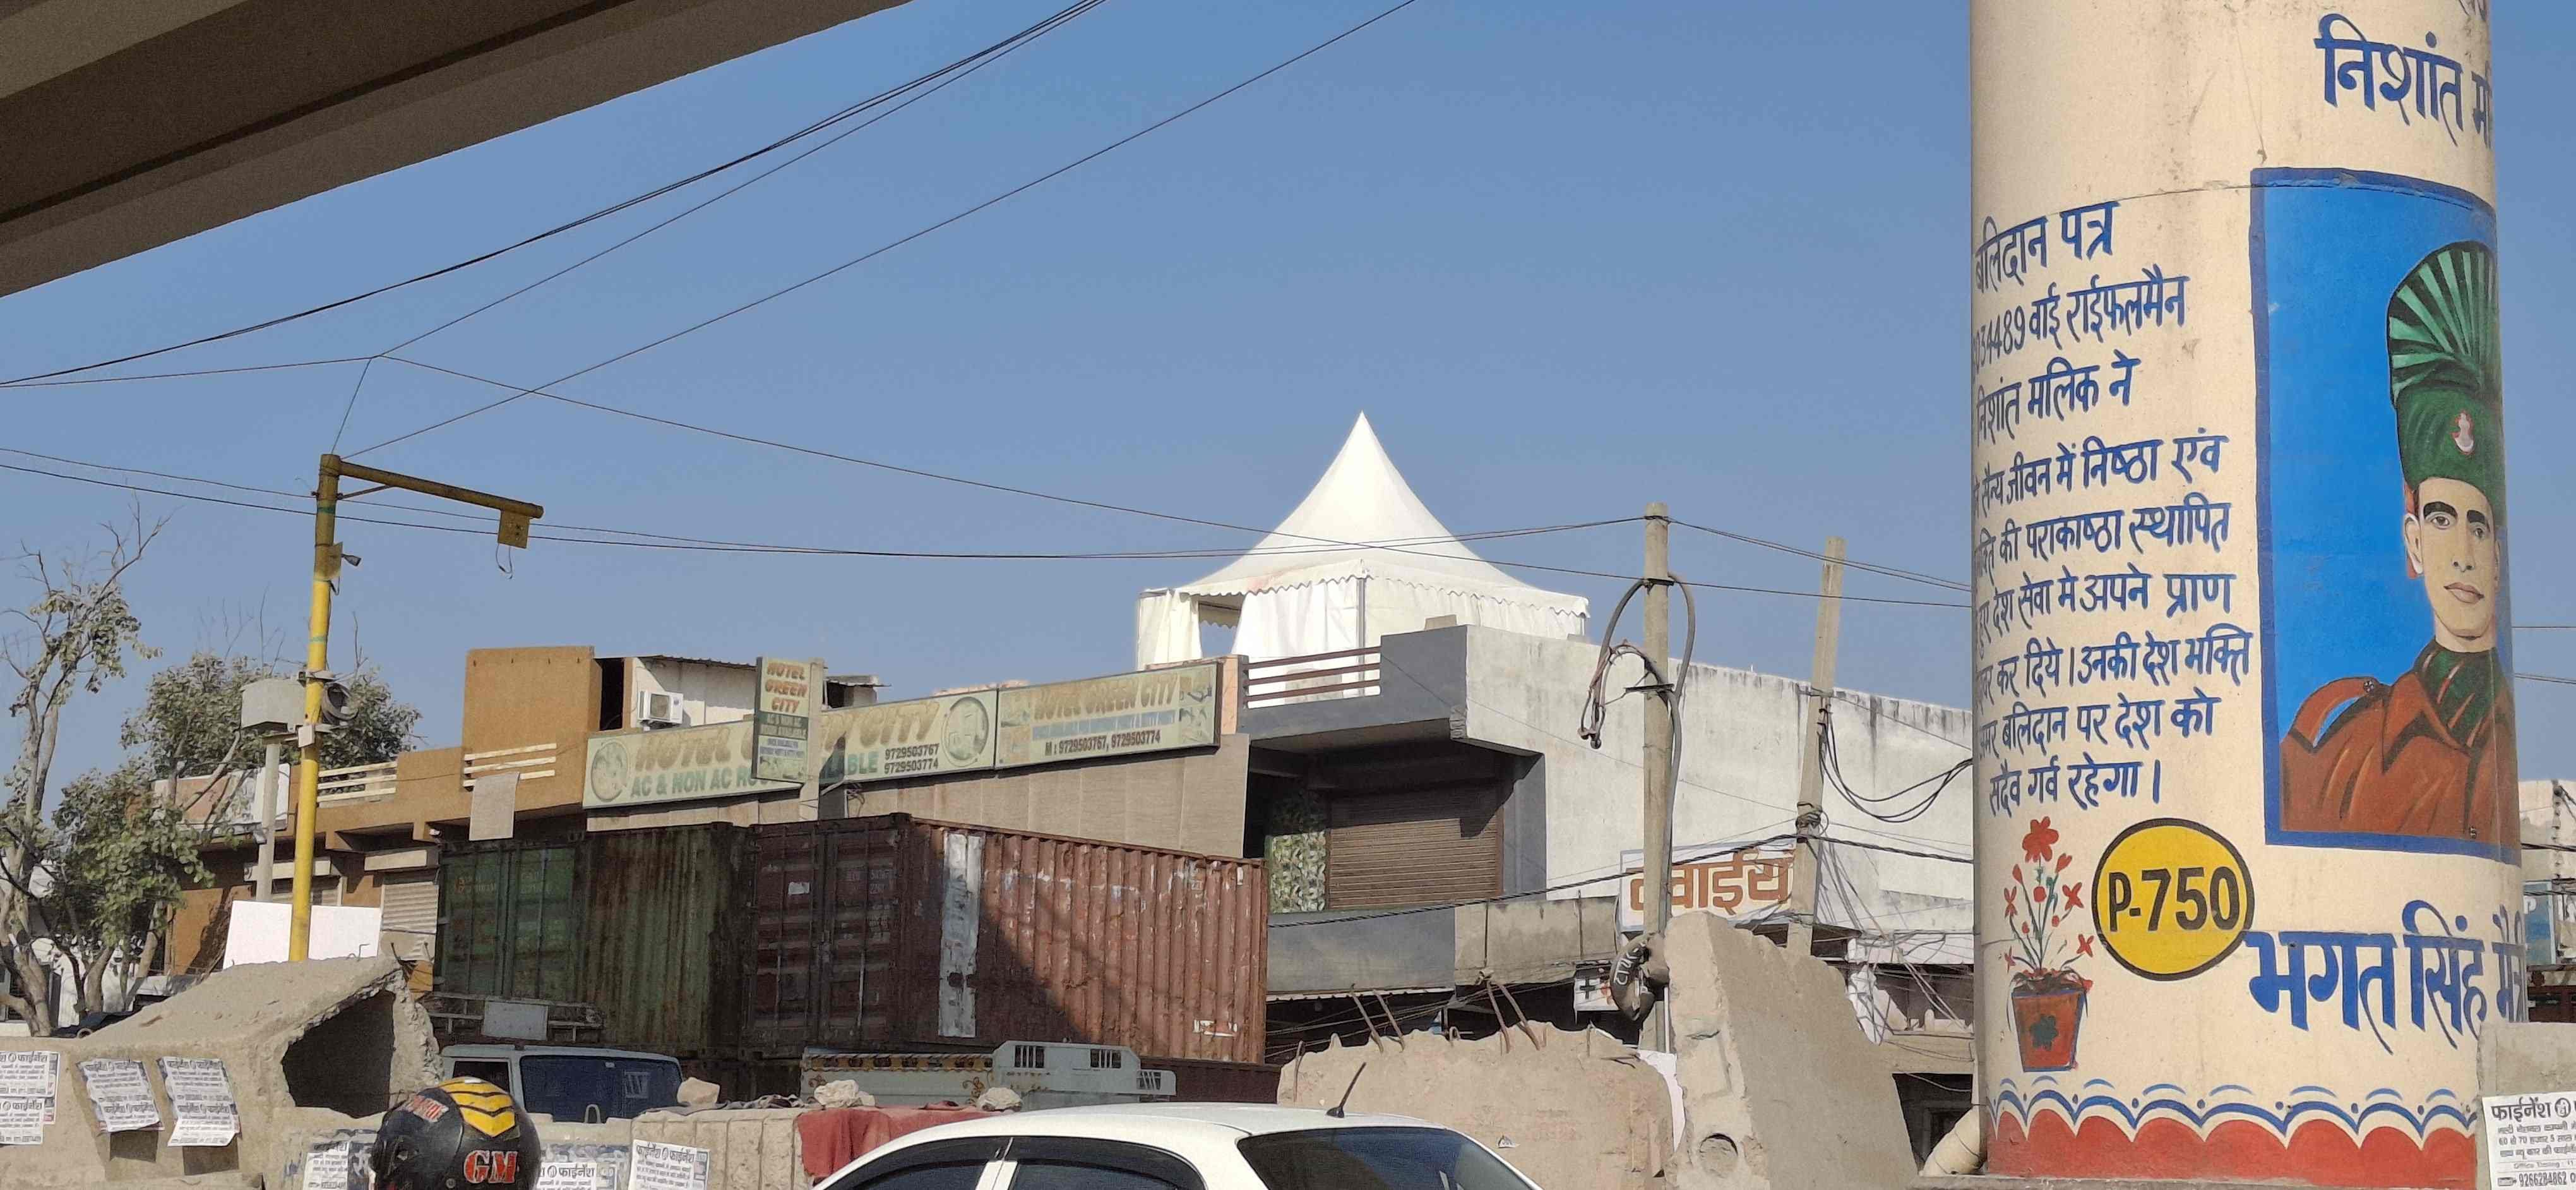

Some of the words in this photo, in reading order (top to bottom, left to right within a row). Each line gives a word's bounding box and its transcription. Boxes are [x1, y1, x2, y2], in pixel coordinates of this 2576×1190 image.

[2313, 13, 2465, 147] निशांत
[1975, 215, 2048, 294] बलिदान
[2060, 200, 2121, 260] पत्र
[2029, 281, 2063, 349] वाई
[2066, 263, 2191, 344] राईफलमैन
[1976, 376, 2022, 447] निशांत
[2028, 356, 2101, 421] मलिक
[2109, 348, 2142, 406] ने
[2006, 450, 2052, 505] जीवन
[2056, 442, 2077, 493] में
[2080, 435, 2164, 490] निष्ठा
[2000, 517, 2022, 565] की
[2025, 509, 2125, 562] पराकाष्ठा
[2129, 492, 2232, 554] स्थापित
[1993, 587, 2015, 639] देश
[2017, 570, 2054, 630] सेवा
[2080, 562, 2153, 612] अपने
[2162, 573, 2237, 618] प्राण
[765, 678, 808, 698] GREEN
[766, 661, 806, 681] HOTEL
[1140, 673, 1179, 707] CITY
[1997, 655, 2020, 697] कर
[2024, 636, 2063, 698] दिये
[2078, 631, 2140, 685] उनकी
[2142, 630, 2181, 687] देश
[2185, 622, 2254, 687] भक्ति
[771, 697, 800, 714] CITY
[859, 700, 941, 748] CITY
[2003, 700, 2070, 755] बलिदान
[2077, 704, 2111, 745] पर
[2114, 692, 2166, 750] देश
[2170, 687, 2222, 738] को
[884, 758, 939, 774] 9729503774
[885, 743, 940, 760] 9729503767
[1111, 729, 1162, 750] 9729503774
[630, 775, 653, 798] AC
[655, 773, 668, 796] &
[671, 768, 708, 795] NON
[709, 766, 734, 790] AC
[1989, 760, 2022, 818] सदैव
[2027, 755, 2061, 804] गर्व
[2066, 751, 2144, 810] रहेगा
[2109, 866, 2241, 932] P-750
[2243, 930, 2398, 1055] भगत
[2401, 899, 2487, 1049] सिंह
[2490, 1096, 2552, 1122] फाईनेंश
[463, 1150, 518, 1184] GM
